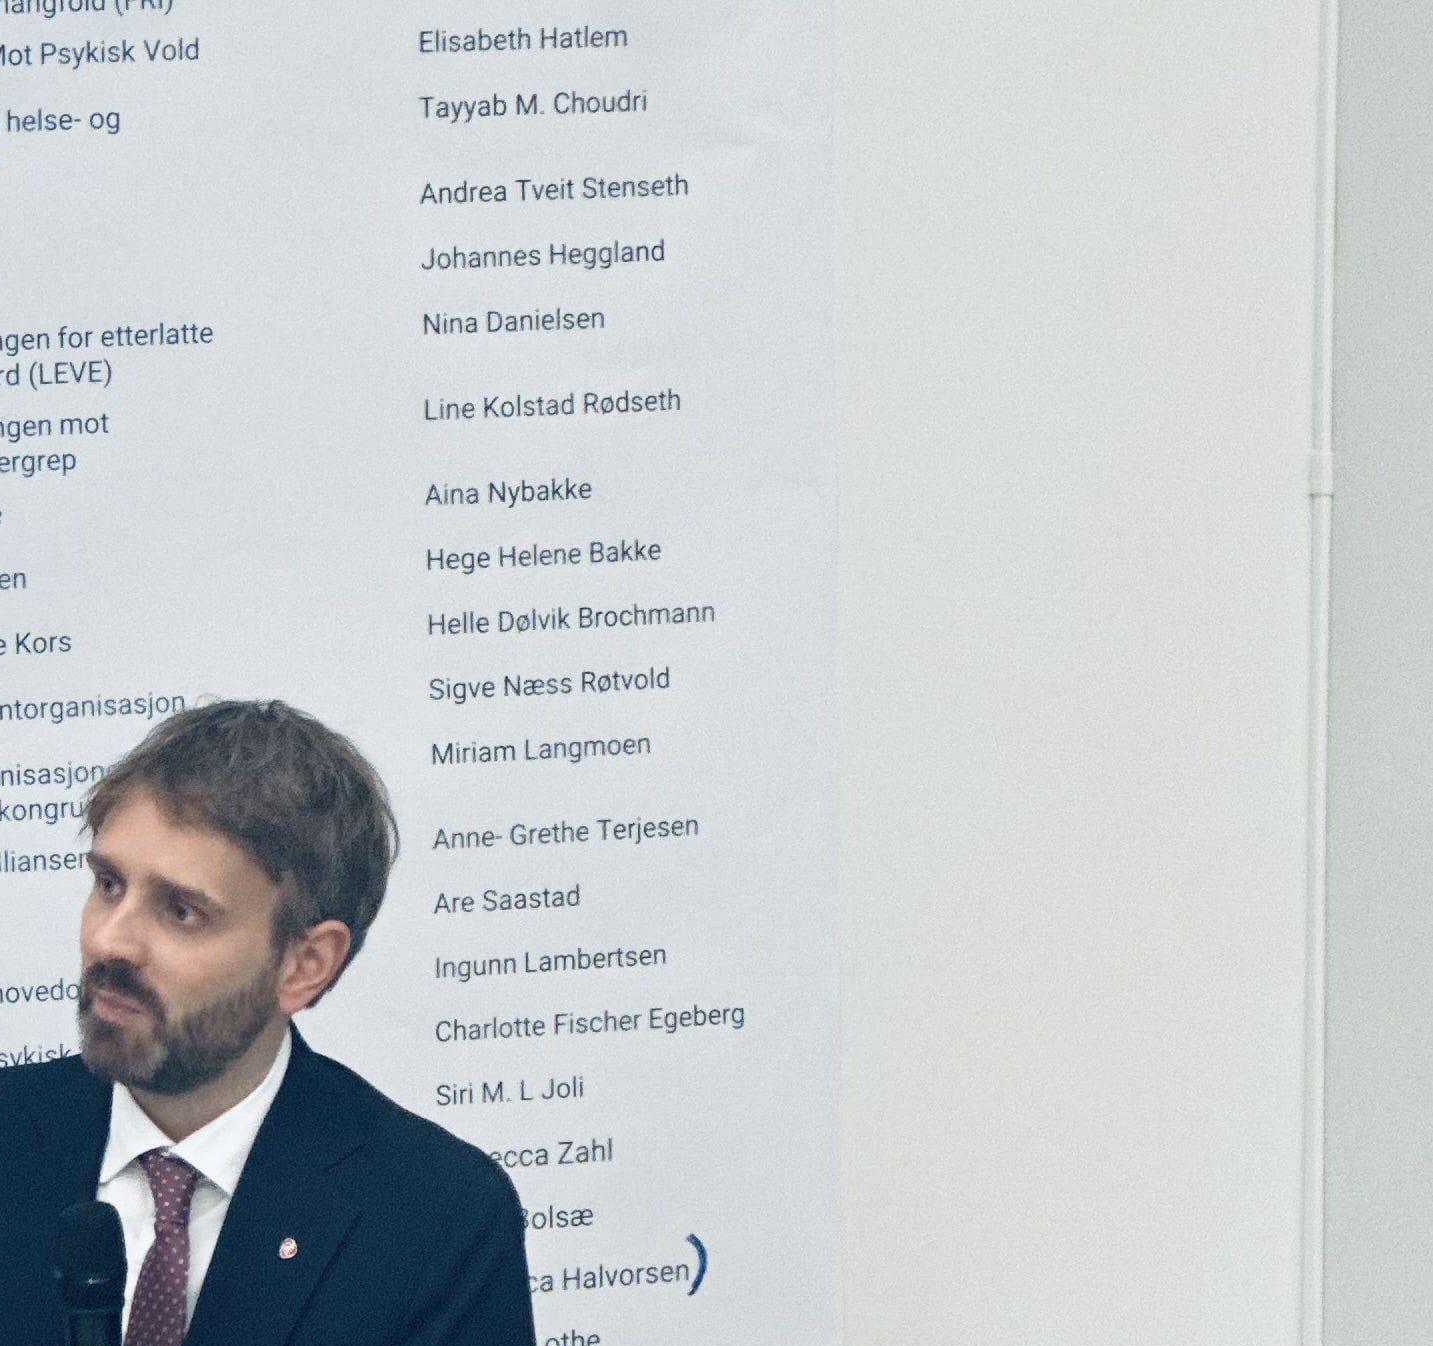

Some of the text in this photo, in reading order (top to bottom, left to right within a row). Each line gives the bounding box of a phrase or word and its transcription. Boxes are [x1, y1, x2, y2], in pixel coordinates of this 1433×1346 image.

[40, 40, 135, 70] Psykisk
[144, 37, 200, 62] Vold
[419, 25, 628, 53] Elisabeth Hatlem
[6, 108, 82, 133] helse-
[90, 112, 121, 135] og
[418, 89, 648, 124] Tayyab M. Choudri
[419, 173, 689, 205] Andrea Tveit Stenseth
[421, 239, 665, 271] Johannes Heggland
[58, 325, 93, 350] for
[100, 322, 214, 348] etterlatte
[423, 307, 605, 335] Nina Danielsen
[29, 359, 112, 391] (LEVE)
[424, 388, 681, 421] Line Kolstad Rødseth
[60, 413, 110, 436] mot
[425, 477, 592, 508] Aina Nybakke
[426, 539, 662, 575] Hege Helene Bakke
[428, 602, 716, 635] Helle Dølvik Brochmann
[16, 631, 72, 655] Kors
[429, 666, 670, 704] Sigve Næss Røtvold
[431, 736, 651, 766] Miriam Langmoen
[432, 817, 699, 850] Anne- Grethe Terjesen
[434, 884, 581, 914] Are Saastad
[435, 947, 667, 983] Ingunn Lambertsen
[436, 1004, 745, 1042] Charlotte Fischer Egeberg
[436, 1076, 584, 1106] Siri M. L Joli
[489, 1138, 613, 1169] ecca Zahl
[529, 1275, 554, 1293] ca
